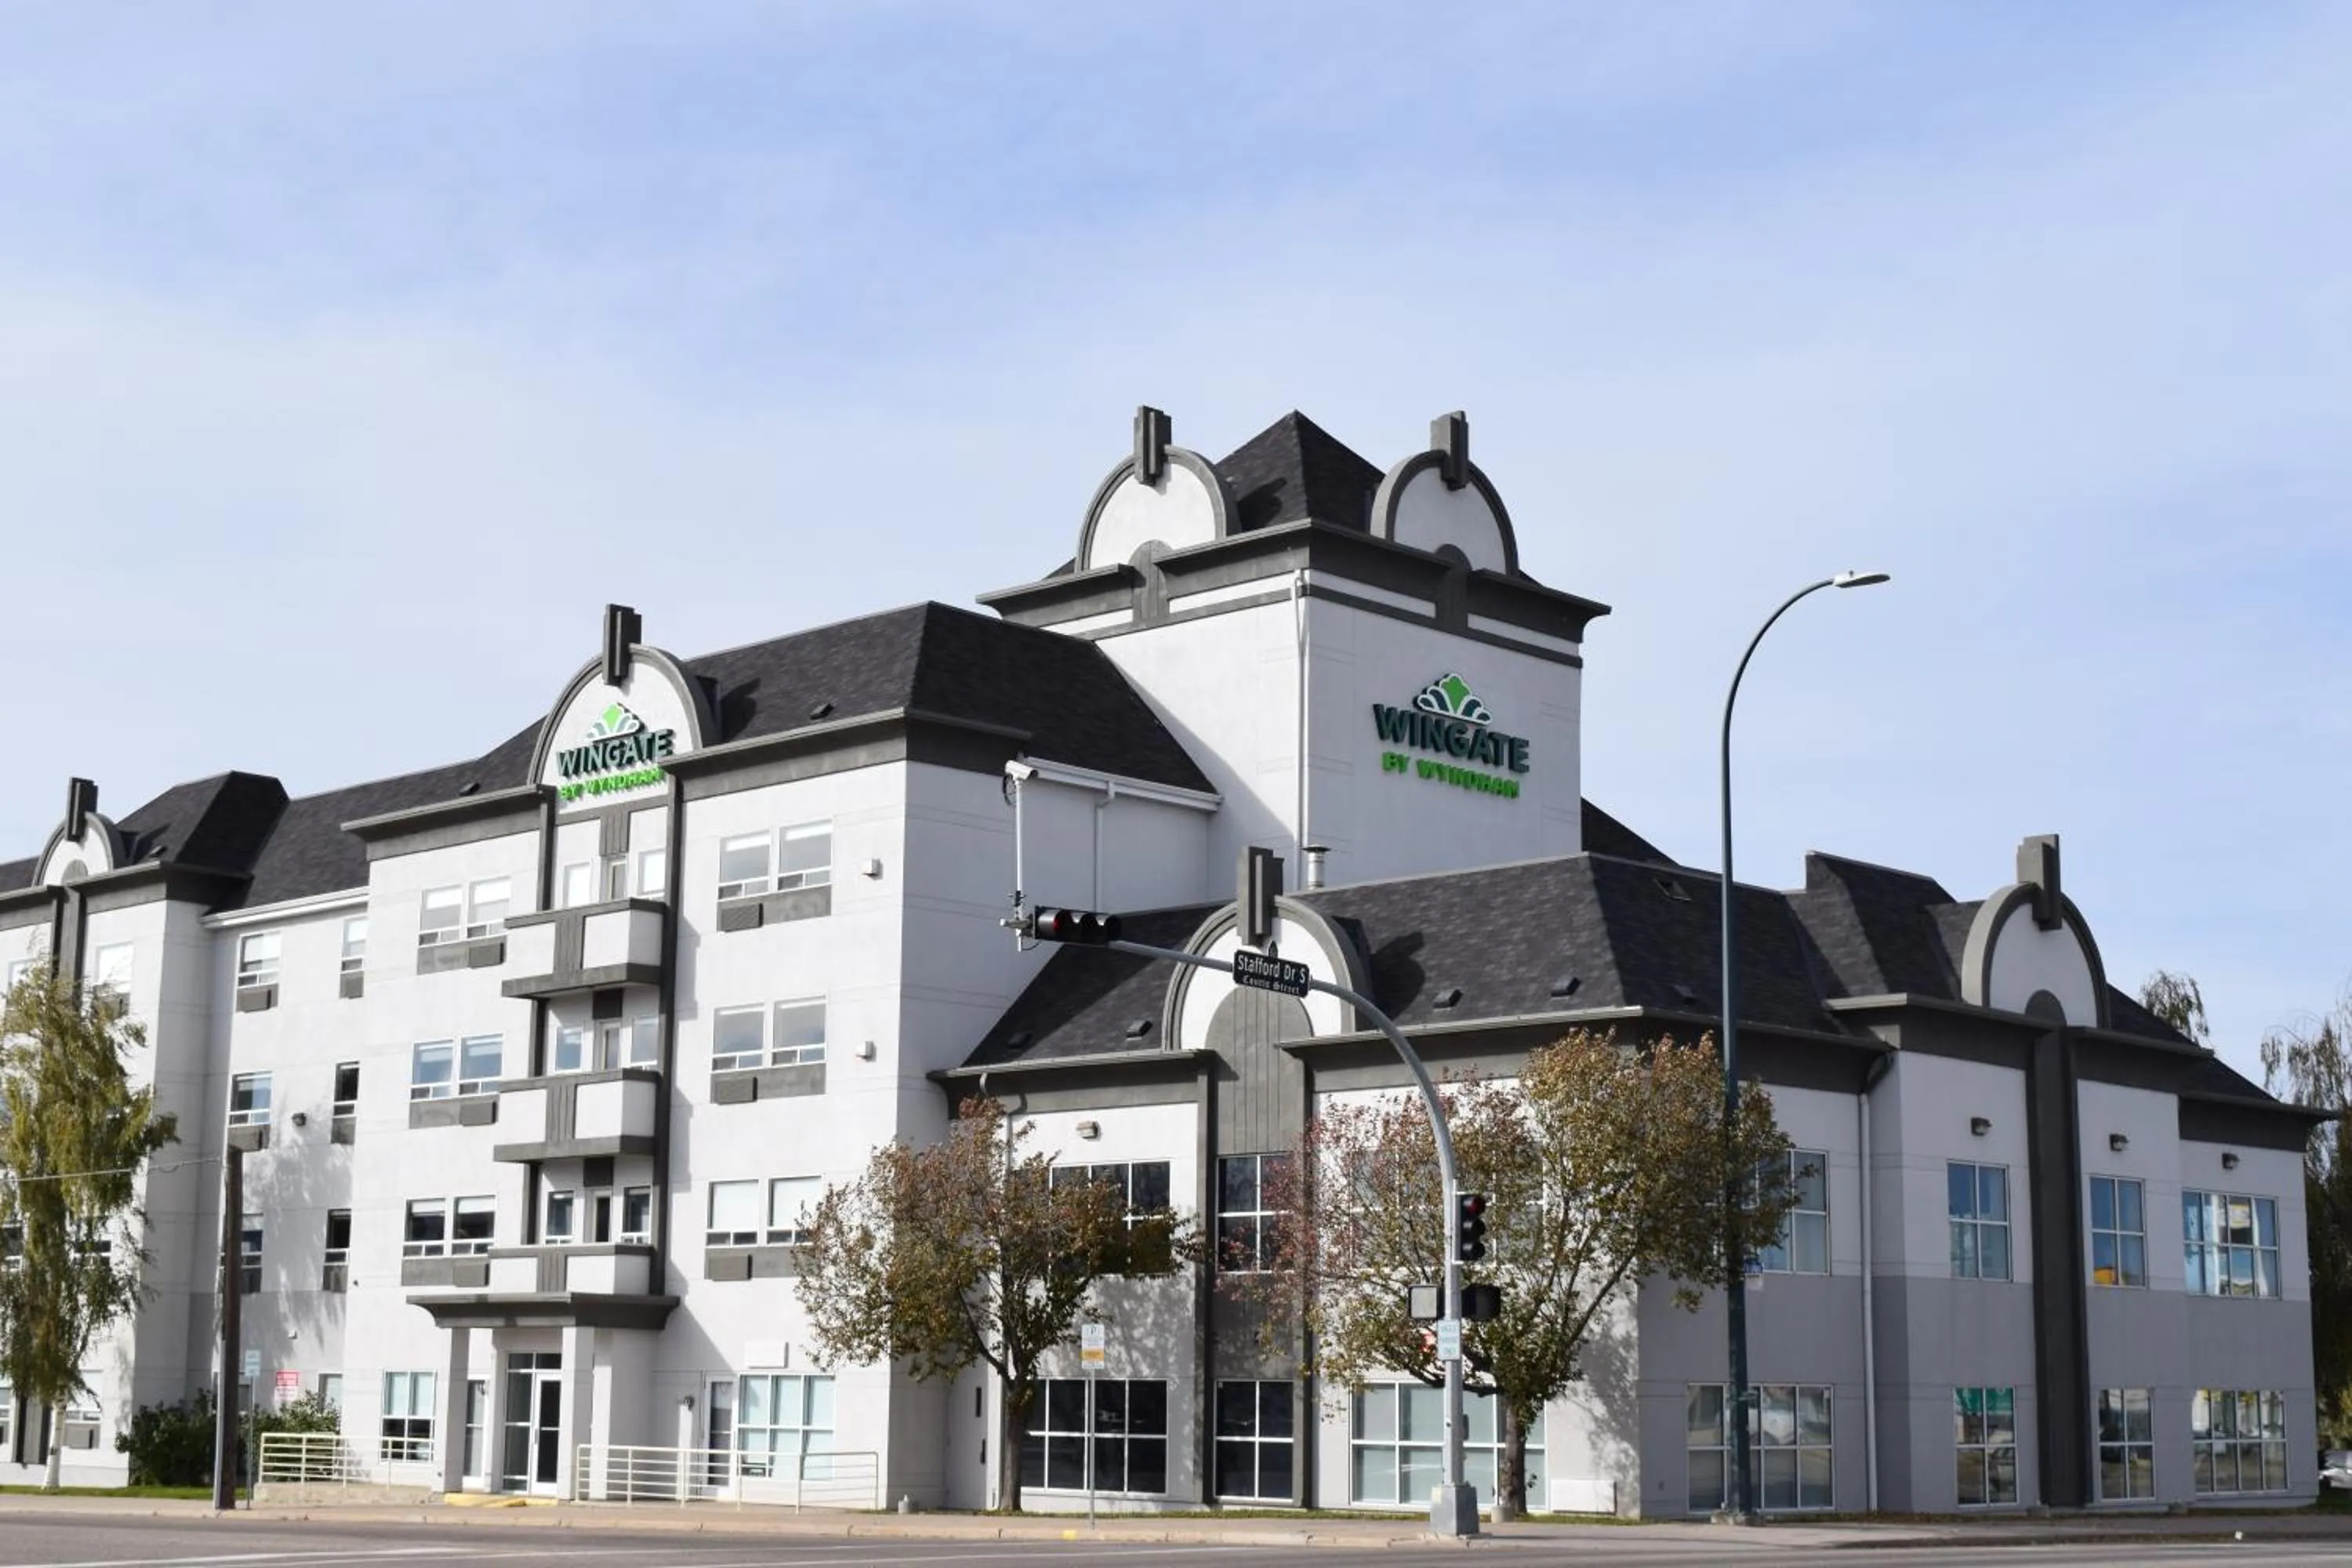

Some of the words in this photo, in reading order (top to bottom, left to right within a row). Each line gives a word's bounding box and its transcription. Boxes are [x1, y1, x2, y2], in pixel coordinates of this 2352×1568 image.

[556, 728, 675, 779] WINGATE
[1373, 703, 1530, 774] WINGATE
[558, 783, 584, 800] BY
[586, 765, 666, 795] WYNDHAM
[1381, 751, 1410, 773] BY
[1416, 758, 1519, 800] WYNDHAM
[1238, 954, 1281, 978] Stafford
[1283, 964, 1296, 982] Dr
[1299, 967, 1306, 985] S
